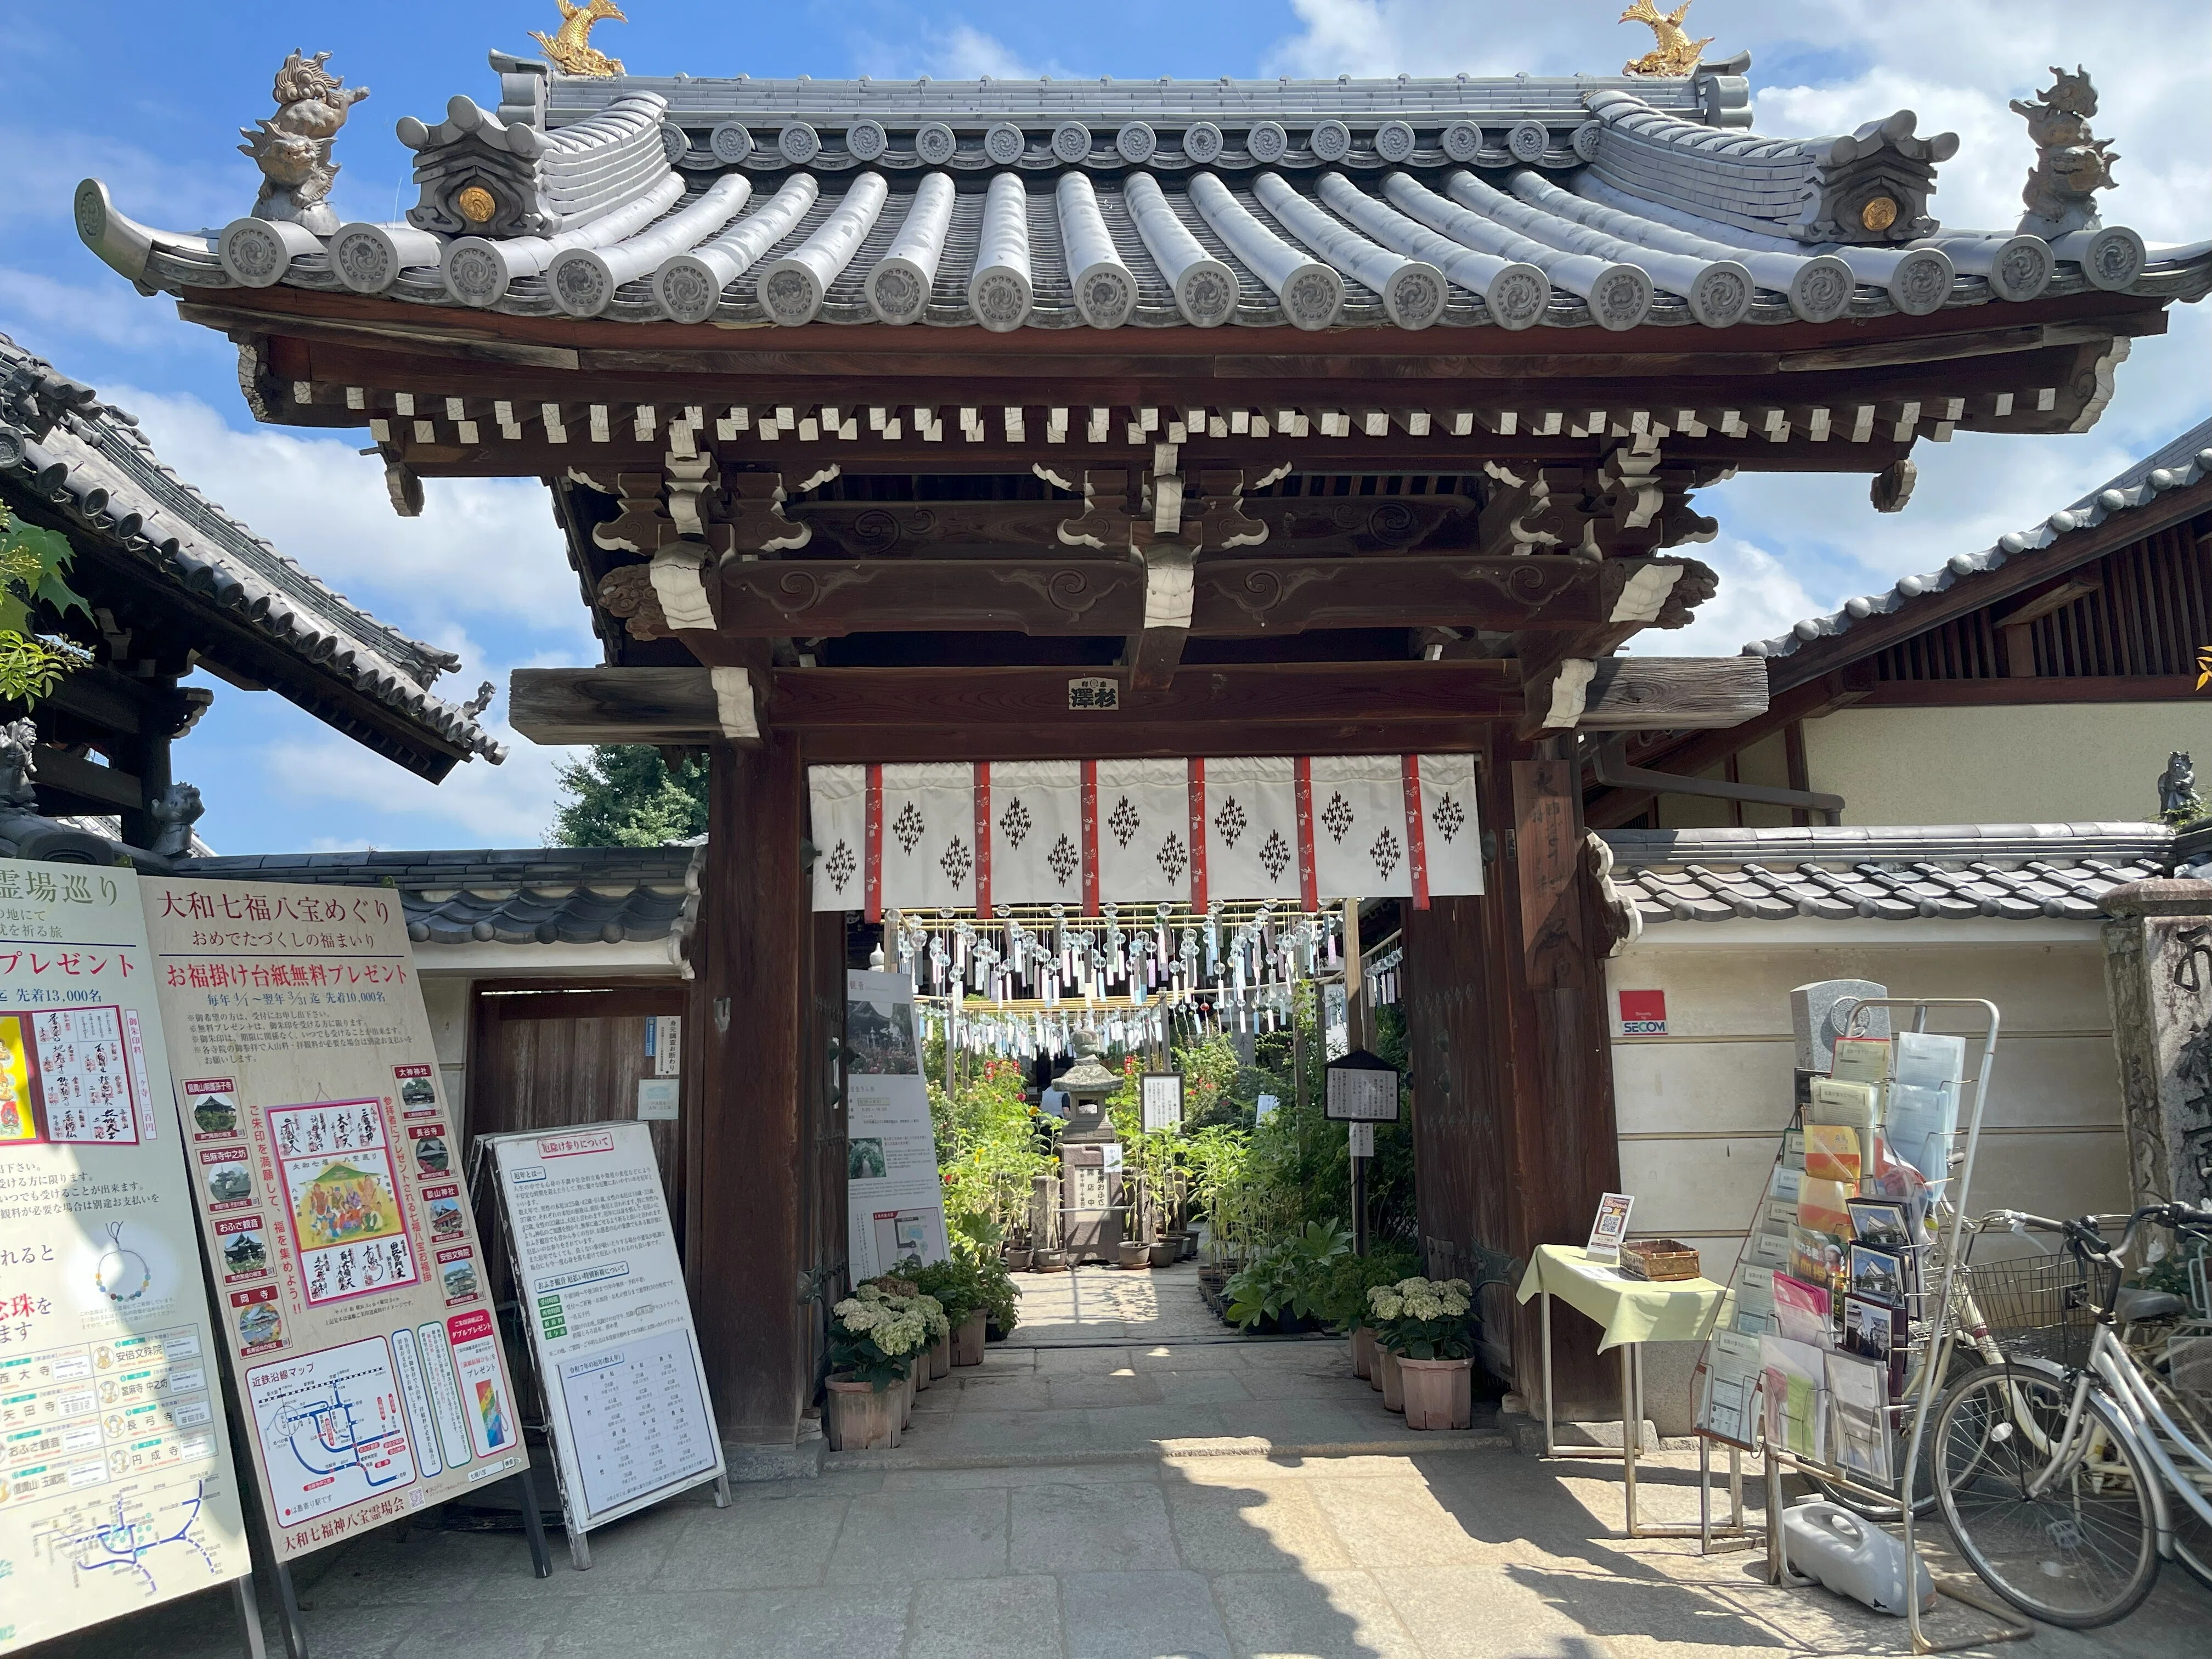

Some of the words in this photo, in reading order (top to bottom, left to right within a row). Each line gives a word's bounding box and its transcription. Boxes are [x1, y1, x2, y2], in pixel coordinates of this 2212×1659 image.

[0, 870, 117, 906] 霊場巡り
[157, 891, 388, 924] 大和七福八宝めぐり
[193, 931, 374, 949] おめでたづくしの福まいり
[0, 951, 134, 978] プレゼント
[168, 964, 407, 988] お福掛け台紙無料プレゼント
[16, 989, 101, 1002] 先着13,000名
[1624, 1022, 1665, 1032] SECOM
[399, 1067, 428, 1076] 大神神社
[416, 1127, 438, 1137] 長谷寺
[541, 1136, 610, 1154] 厄除け参りについて
[219, 1218, 258, 1233] おふさ観音
[452, 1323, 492, 1339] ダブルプレゼント
[252, 1362, 314, 1387] 近鉄沿線マップ
[467, 1364, 496, 1379] プレゼント
[285, 1497, 404, 1553] 大和七福神八宝霊場会
